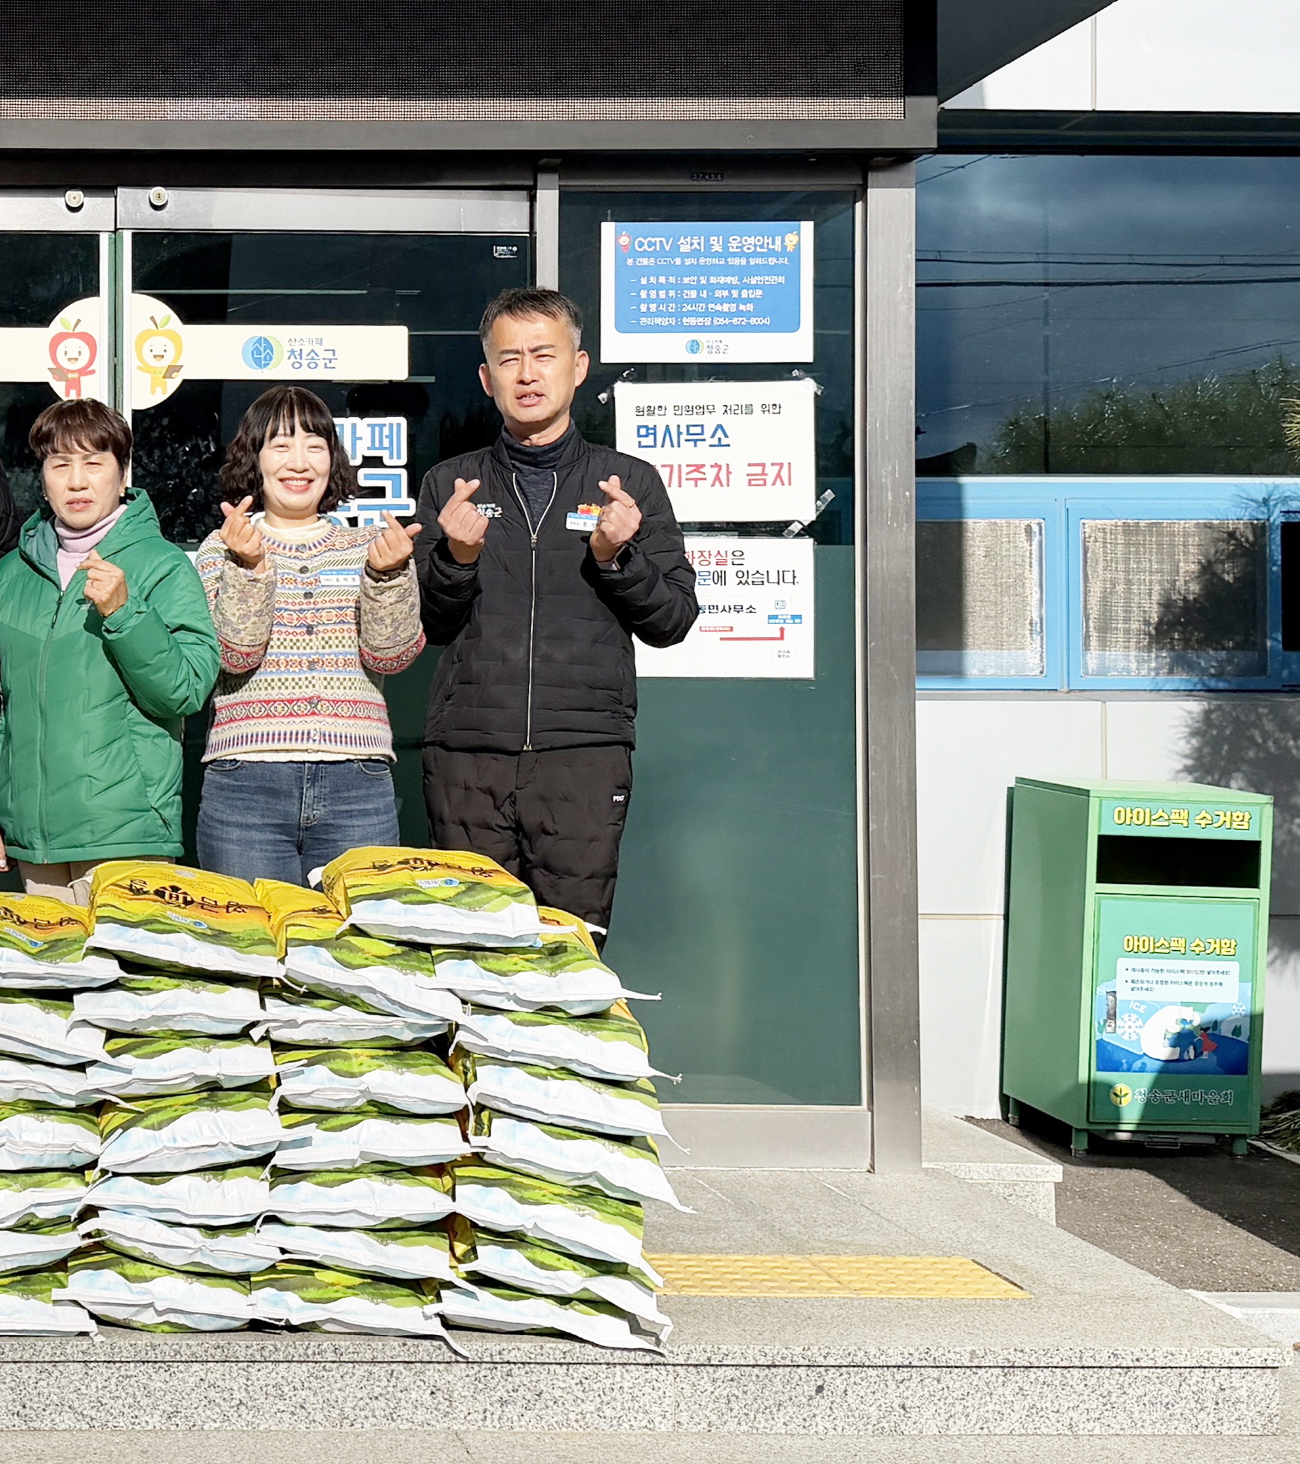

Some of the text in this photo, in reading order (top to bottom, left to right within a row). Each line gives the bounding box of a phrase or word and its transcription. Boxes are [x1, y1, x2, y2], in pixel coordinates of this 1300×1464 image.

[634, 235, 781, 252] CCTV 설치 및 운영안내
[288, 337, 323, 346] 산소카페
[287, 349, 338, 369] 청송군
[635, 403, 782, 417] 원활한 민원업무 처리를 위한
[636, 424, 731, 448] 면사무소
[655, 462, 792, 488] 기주차 금지
[735, 569, 799, 586] 있습니다.
[1113, 806, 1252, 831] 아이스팩 수거함
[1123, 935, 1237, 956] 아이스팩 수거함
[1129, 1001, 1147, 1014] ICE
[1134, 1088, 1234, 1106] 청송군새마을회
